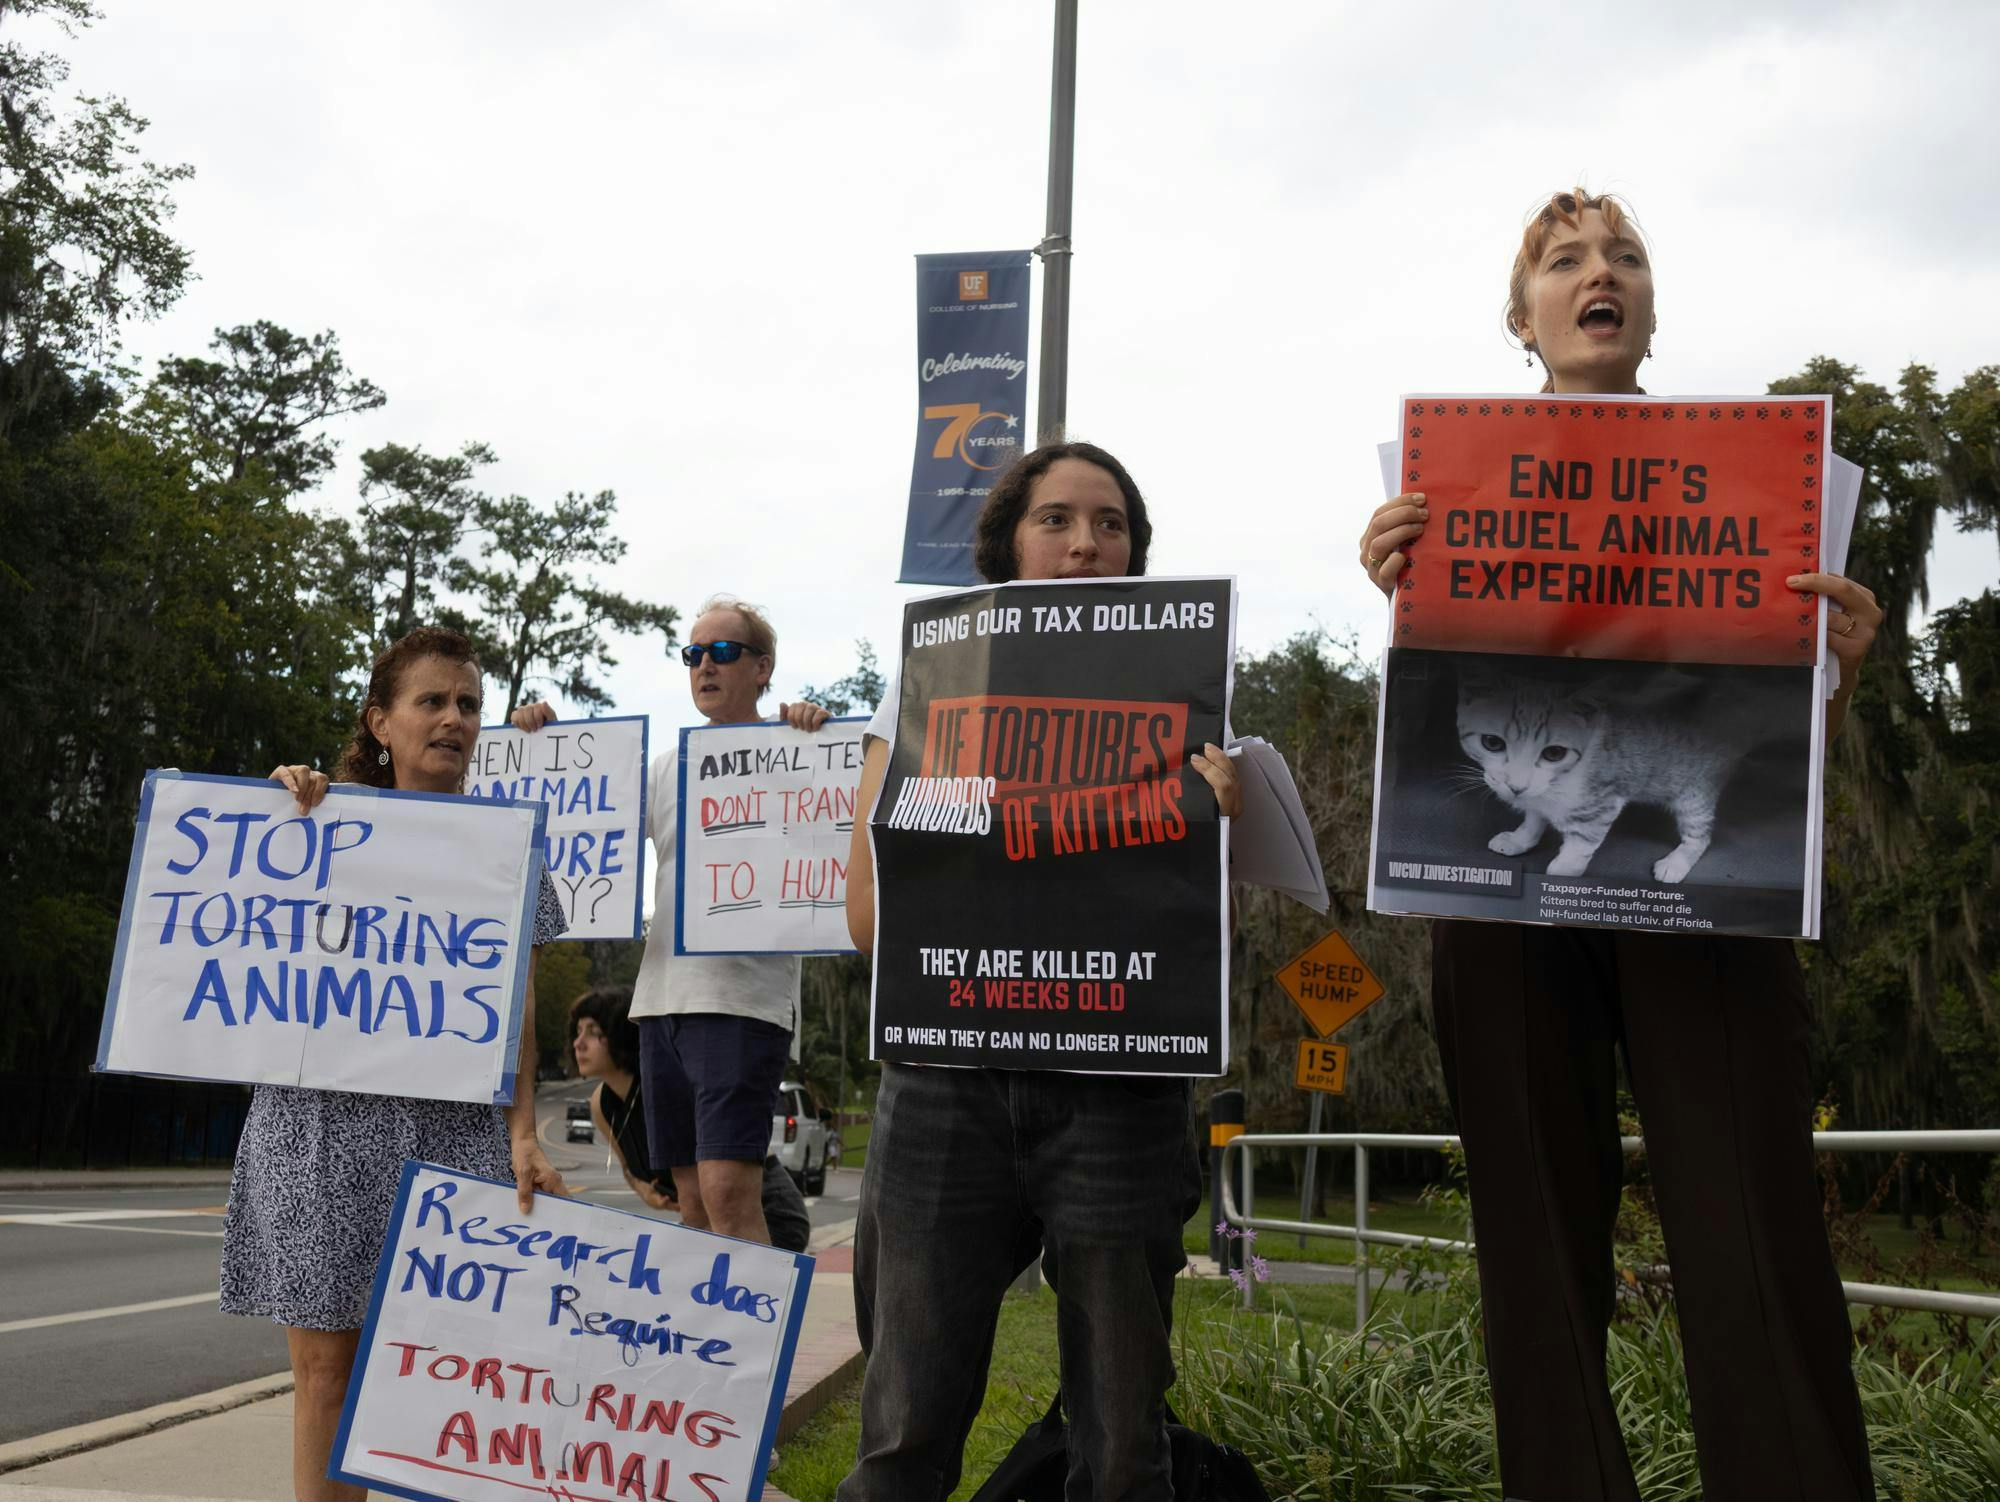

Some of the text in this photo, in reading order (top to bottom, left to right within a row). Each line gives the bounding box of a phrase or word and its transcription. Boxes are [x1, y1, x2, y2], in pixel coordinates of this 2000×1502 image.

[964, 276, 984, 290] UF
[929, 305, 965, 313] COLLEGE
[979, 302, 1018, 310] NURSING
[922, 352, 1026, 382] Celebrating
[969, 436, 1015, 448] YEARS
[1510, 454, 1593, 501] END
[1446, 509, 1769, 556] CRUEL ANIMAL
[1450, 559, 1761, 609] EXPERIMENTS
[913, 602, 1215, 648] USING OUR TAX DOLLARS
[469, 732, 594, 776] HEN IS
[932, 706, 1173, 786] UF TORTURES
[700, 747, 809, 780] ANIMAL
[777, 786, 861, 824] TRAN
[889, 776, 996, 836] HUNDREDS
[1003, 778, 1186, 861] OF KITTENS
[167, 807, 372, 891] STOP
[705, 857, 848, 902] TO HUM
[1389, 861, 1512, 886] WCW INVESTIGATION
[1540, 896, 1692, 915] Kittens bred to suffer and die
[1541, 882, 1685, 901] Taxpayer-Funded Torture:
[1539, 908, 1713, 929] NIH-funded lab at Univ. of Florida
[920, 948, 1156, 980] THEY ARE KILLED AT
[1300, 960, 1364, 984] SPEED
[183, 959, 503, 1043] ANIMALS
[950, 979, 1125, 1012] 24 WEEKS OLD
[1300, 982, 1359, 1003] HUMP
[884, 1026, 1208, 1054] OR WHEN THEY CAN NO LONGER FUNCTION
[1308, 1048, 1337, 1072] 15
[1306, 1074, 1334, 1087] MPH
[416, 1182, 779, 1323] Research does
[401, 1247, 736, 1367] NOT Require
[384, 1341, 741, 1448] TORTURING
